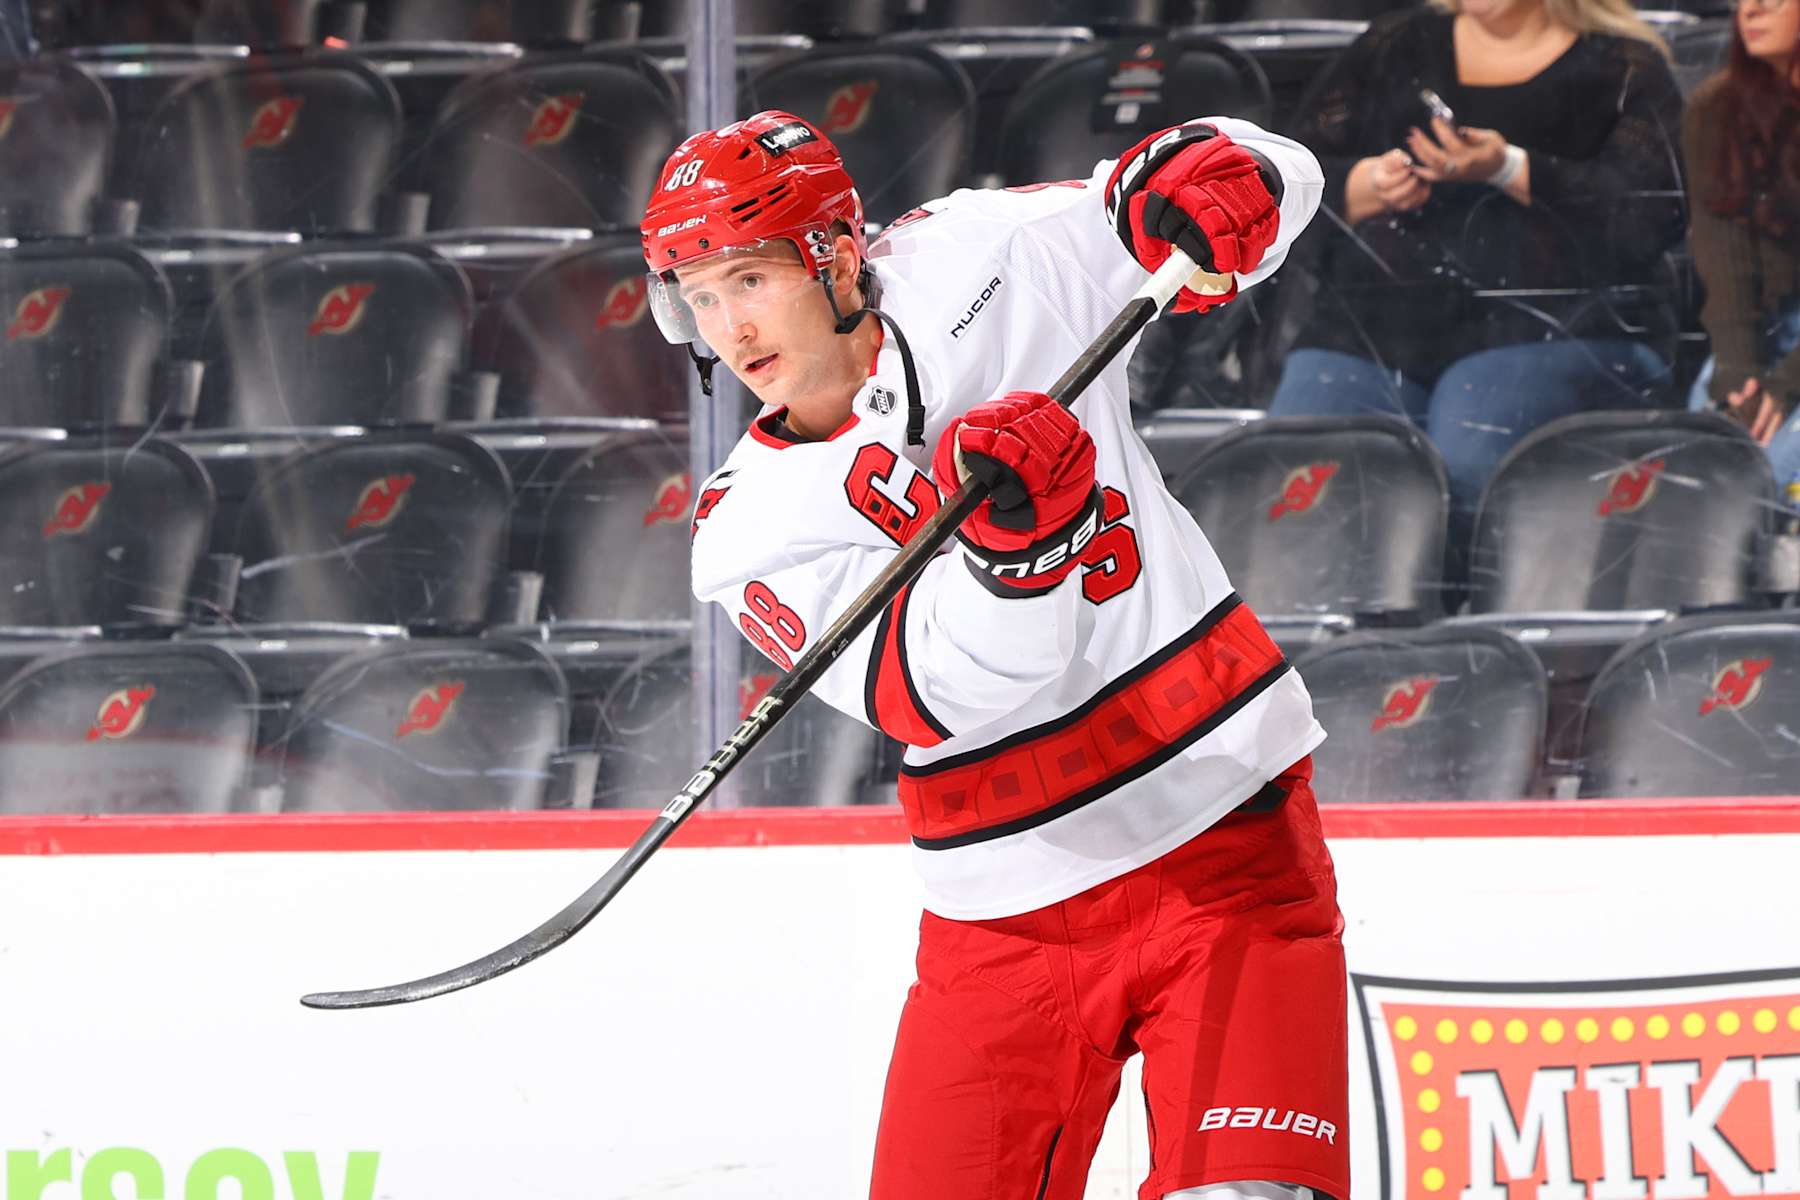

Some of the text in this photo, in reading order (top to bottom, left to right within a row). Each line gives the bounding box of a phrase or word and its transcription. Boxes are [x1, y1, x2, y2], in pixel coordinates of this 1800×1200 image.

[664, 159, 705, 192] 88
[951, 276, 1003, 339] NUCOR
[739, 580, 808, 673] 88
[658, 696, 784, 823] BAUER
[1197, 1106, 1338, 1145] BAUER
